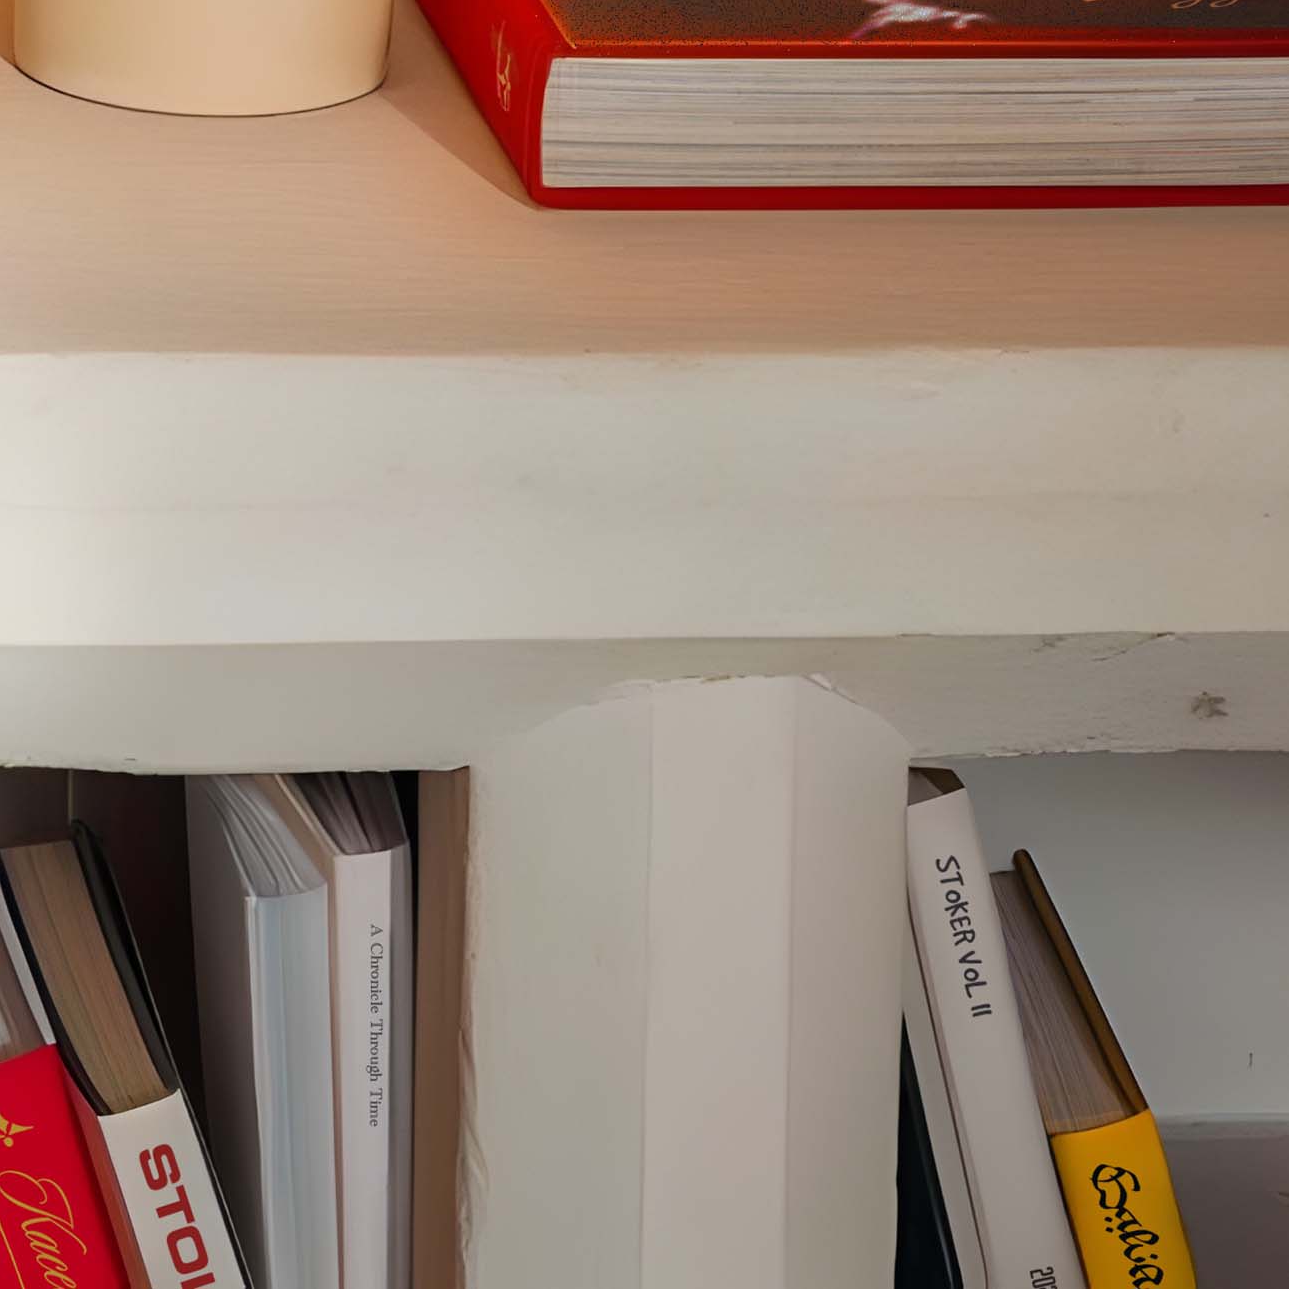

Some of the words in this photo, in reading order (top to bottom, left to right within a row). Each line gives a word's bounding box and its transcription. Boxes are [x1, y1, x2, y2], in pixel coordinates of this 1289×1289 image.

[370, 924, 384, 938] A
[370, 942, 384, 1014] Chronicle
[970, 1003, 993, 1018] II
[366, 1018, 384, 1082] Through
[369, 1087, 384, 1128] Time
[139, 1144, 216, 1289] STO
[1030, 1266, 1058, 1289] 20
